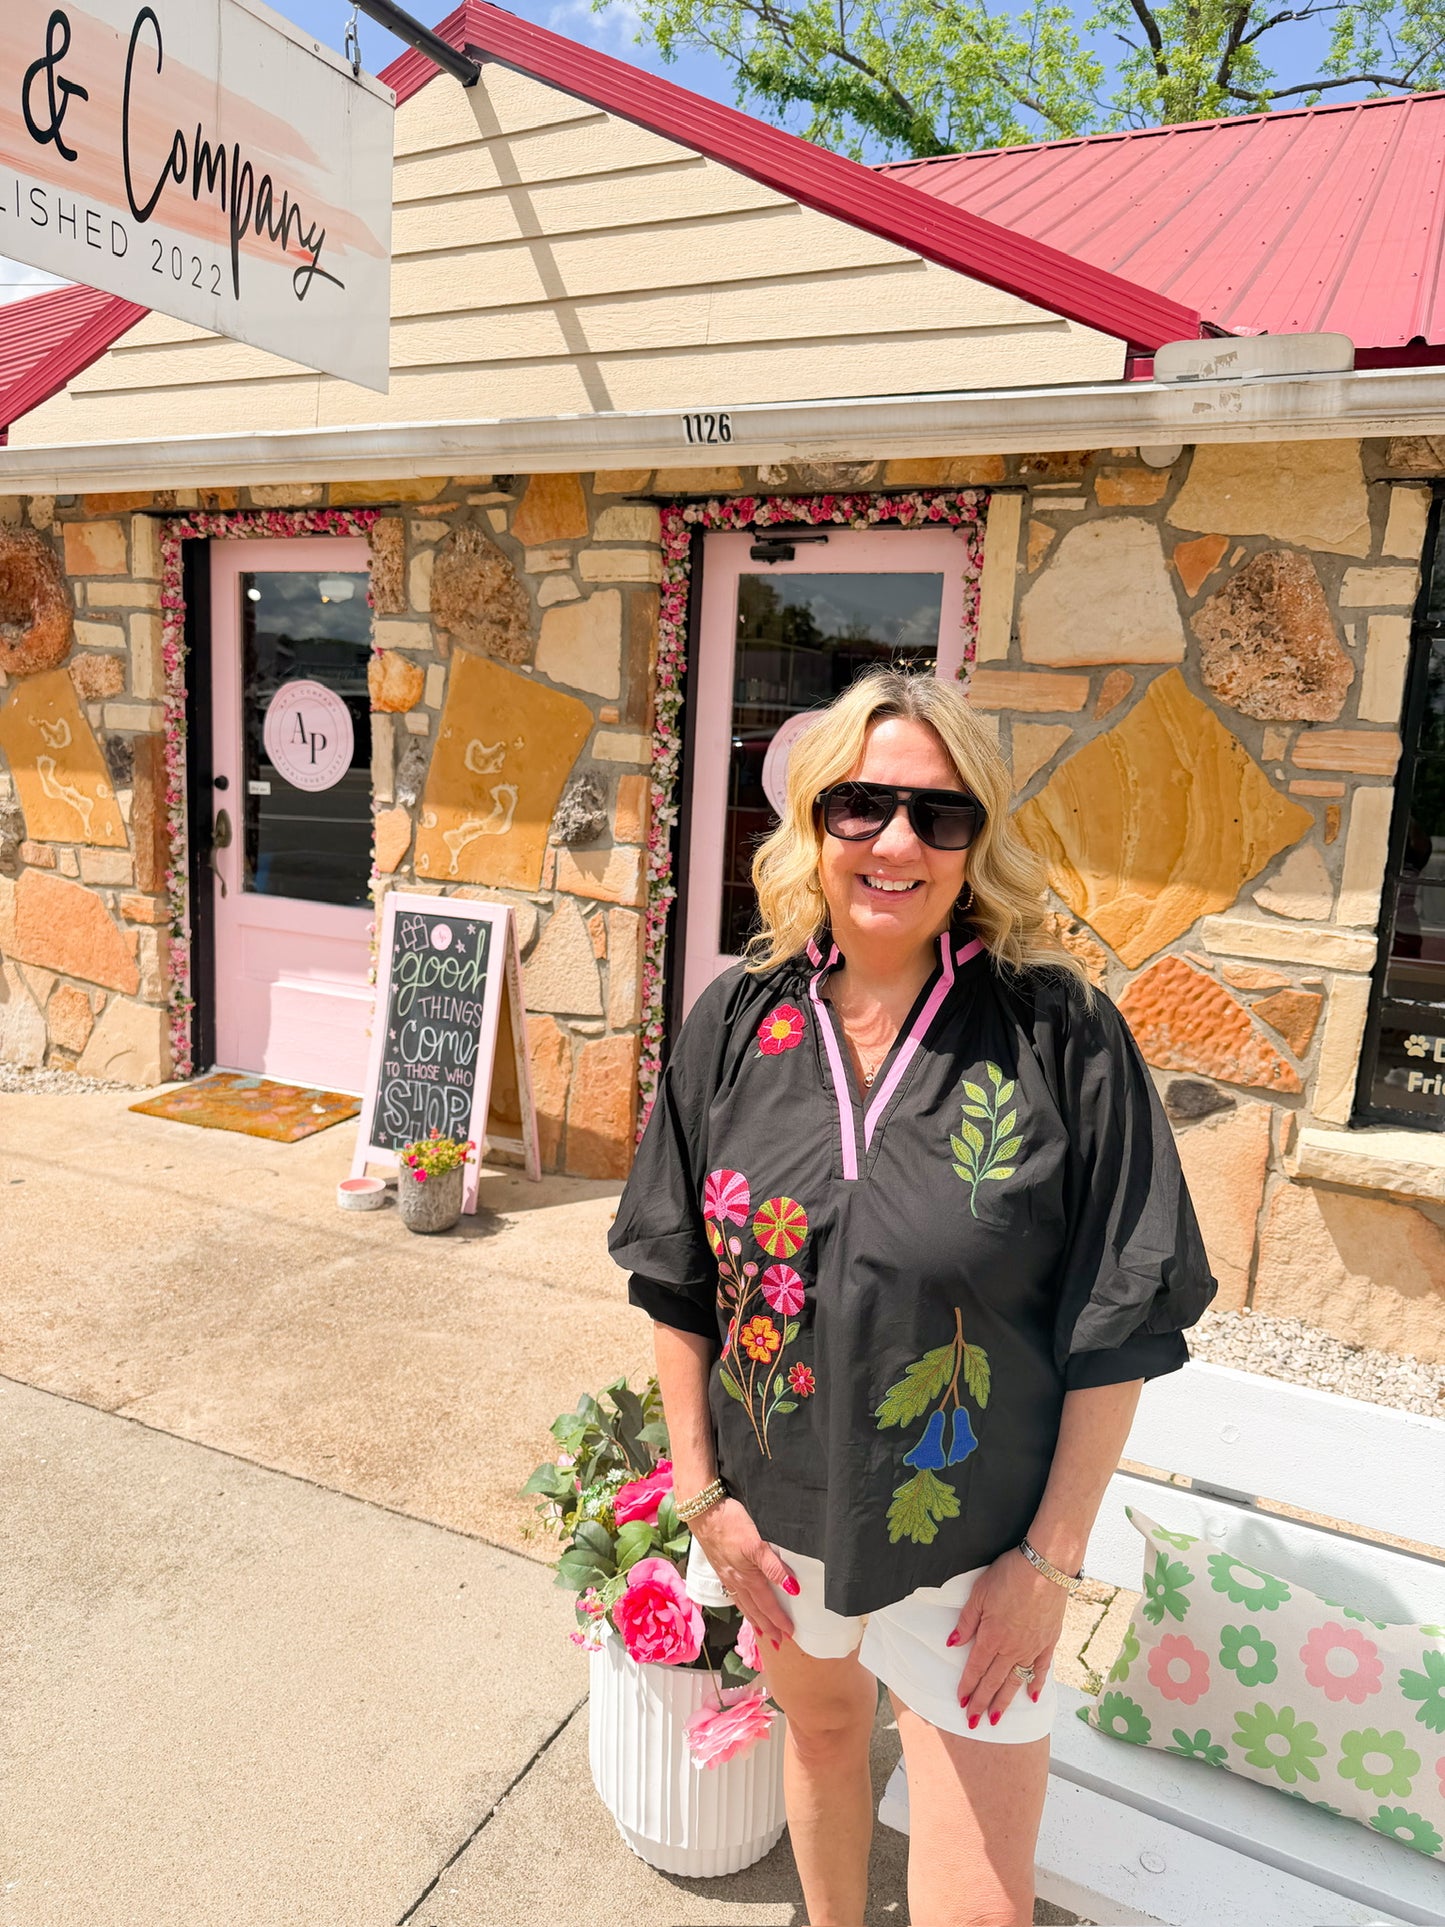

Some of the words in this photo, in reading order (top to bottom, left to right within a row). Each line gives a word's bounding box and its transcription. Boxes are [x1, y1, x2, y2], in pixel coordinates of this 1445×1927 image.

[22, 9, 89, 162] &
[123, 6, 345, 301] Company
[0, 179, 128, 258] ISHED
[151, 238, 221, 297] 2022
[682, 413, 732, 443] 1126
[392, 928, 487, 1017] good
[417, 995, 482, 1029] THINGS
[385, 1062, 400, 1077] TO
[404, 1063, 440, 1080] THOSE
[444, 1066, 473, 1087] WHO
[1408, 1071, 1445, 1096] Fri
